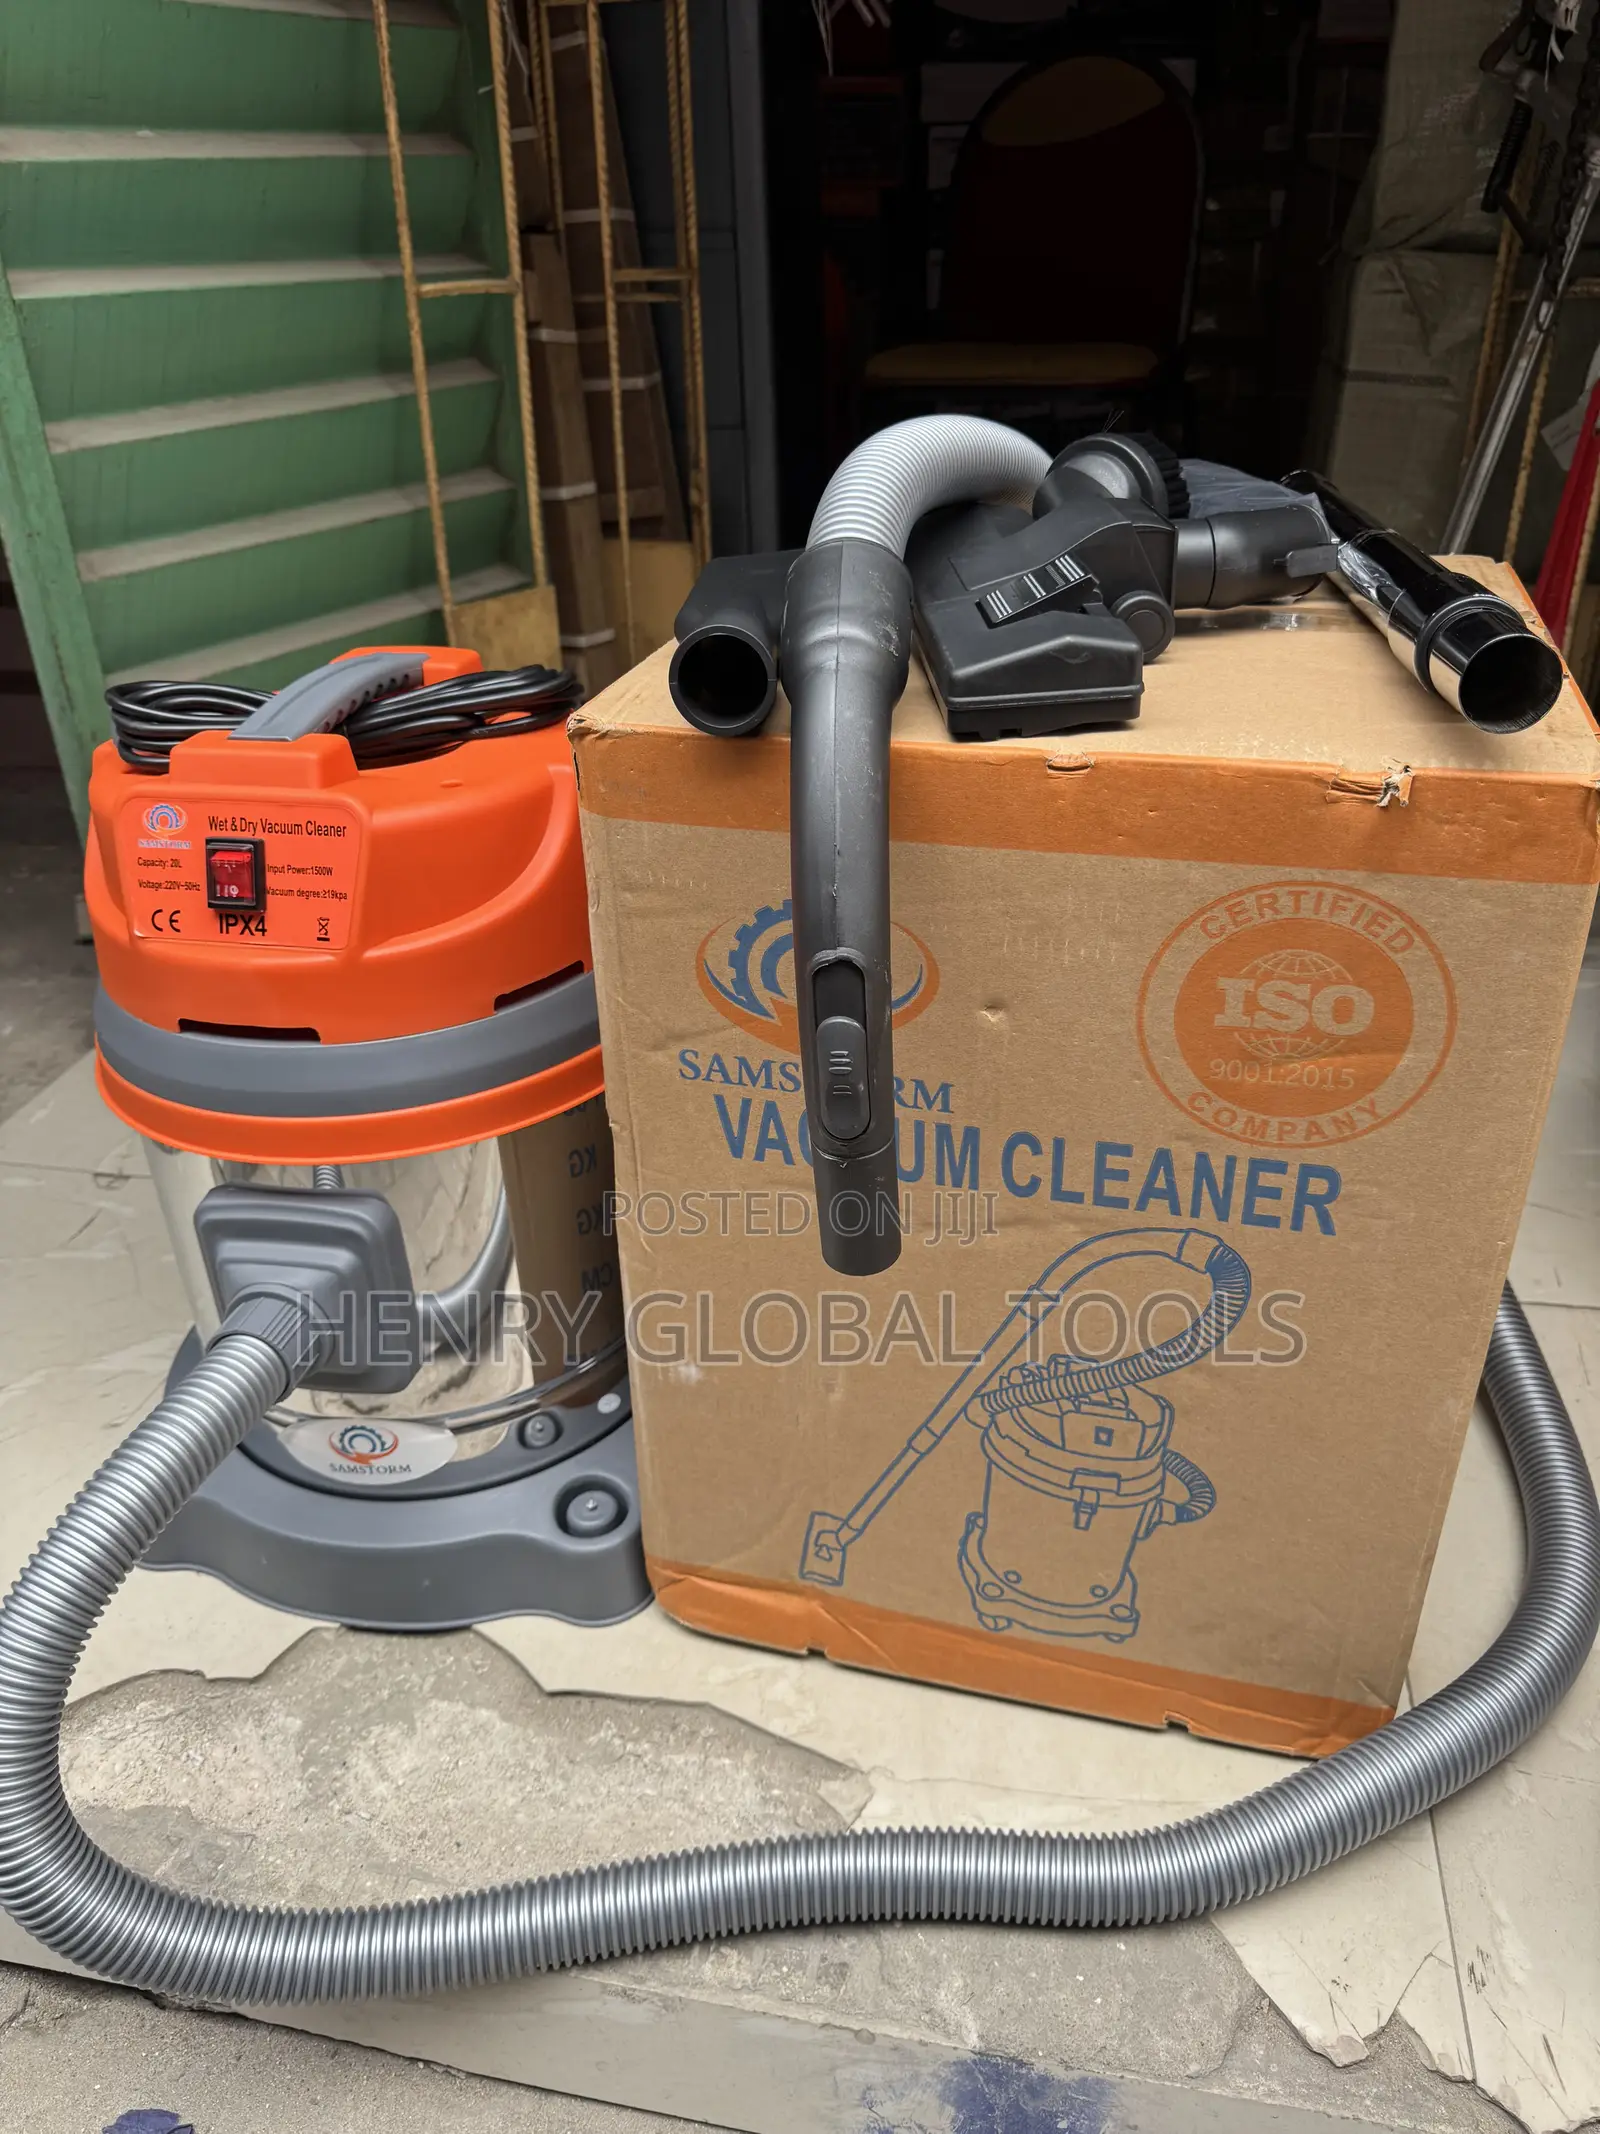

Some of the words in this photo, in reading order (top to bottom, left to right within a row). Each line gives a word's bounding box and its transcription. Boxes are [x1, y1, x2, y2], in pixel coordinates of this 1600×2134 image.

[208, 816, 229, 832] Wet
[230, 817, 239, 832] &
[240, 817, 258, 836] Dry
[260, 818, 304, 836] Vacuum
[305, 820, 347, 838] Cleaner
[137, 856, 169, 870] Capacity:
[267, 864, 286, 876] Input
[287, 864, 334, 877] Power:1500W
[218, 913, 268, 937] IPX4
[1199, 889, 1416, 957] CERTIFIED
[1213, 976, 1376, 1037] ISO
[678, 1048, 955, 1115] SAMSRM
[1187, 1091, 1383, 1145] COMPANY
[713, 1093, 981, 1191] VAUM
[1001, 1130, 1343, 1237] CLEANER
[329, 1462, 413, 1475] SAMSTORM
